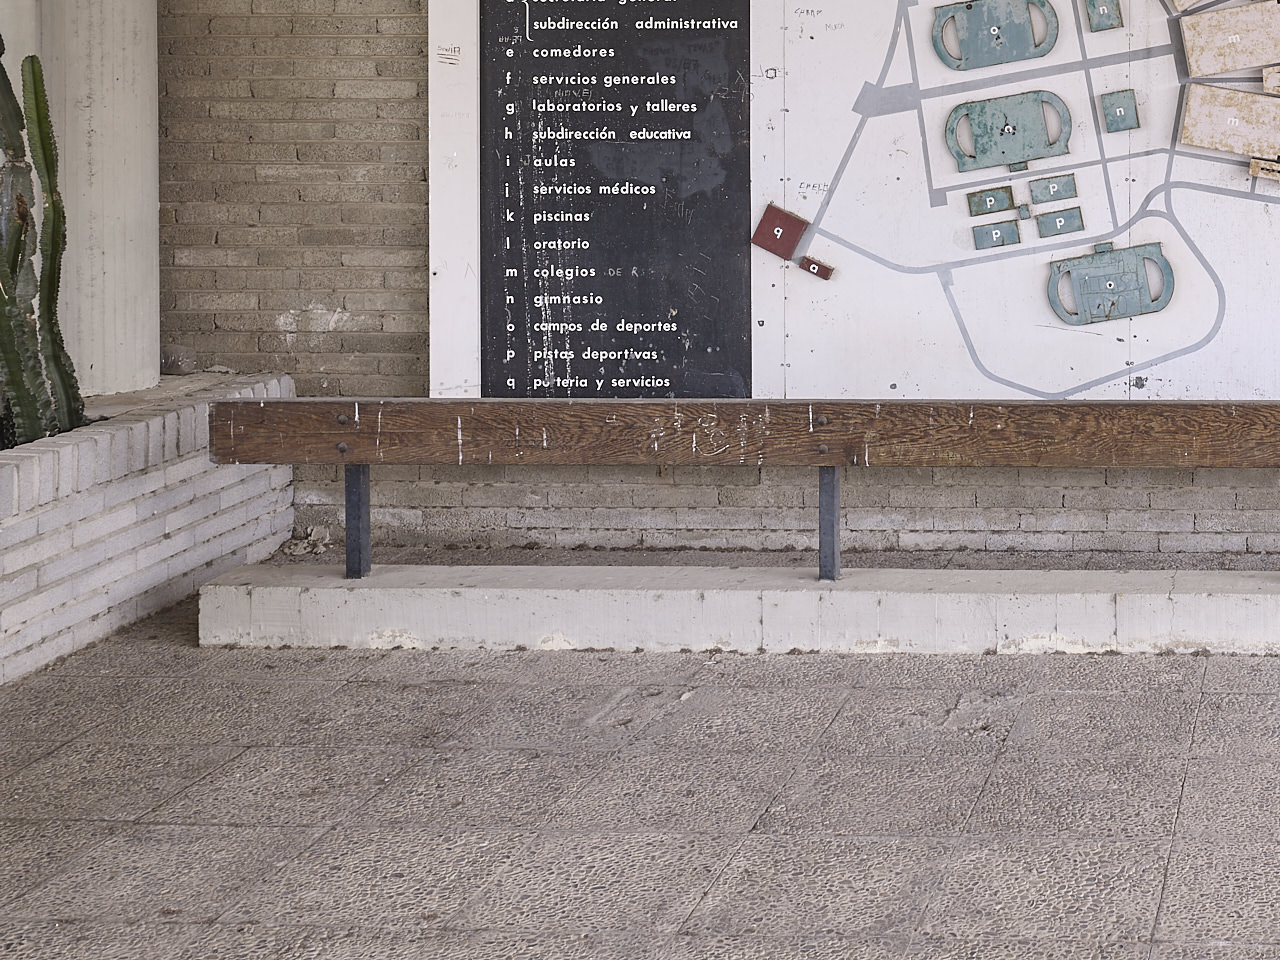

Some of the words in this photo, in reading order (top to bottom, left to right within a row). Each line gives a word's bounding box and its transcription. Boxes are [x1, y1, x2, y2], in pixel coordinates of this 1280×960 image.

[1099, 5, 1107, 15] n
[533, 17, 618, 30] subdirección
[635, 17, 738, 29] administrativa
[990, 26, 998, 35] o
[506, 49, 514, 57] e
[533, 45, 615, 57] comedores
[506, 73, 512, 85] f
[532, 74, 597, 85] servicios
[603, 73, 676, 87] generales
[505, 103, 514, 115] g
[532, 100, 622, 113] laboratorios
[630, 104, 638, 115] y
[646, 100, 697, 113] talleres
[1116, 107, 1124, 116] n
[504, 128, 513, 139] h
[532, 127, 615, 140] subdirección
[629, 128, 691, 140] educativa
[506, 155, 510, 166] i
[533, 155, 576, 167] aulas
[505, 184, 509, 197] j
[533, 184, 591, 195] servicios
[599, 183, 656, 195] médicos
[1049, 183, 1058, 195] p
[986, 197, 995, 208] p
[506, 210, 514, 222] k
[533, 211, 590, 224] piscinas
[1056, 217, 1065, 228] p
[773, 227, 783, 239] q
[992, 229, 1001, 241] p
[506, 238, 510, 249] l
[533, 238, 590, 250] oratorio
[505, 268, 517, 277] m
[533, 266, 596, 280] colegios
[810, 264, 818, 273] a
[1106, 281, 1114, 289] o
[506, 295, 515, 303] n
[534, 293, 603, 307] gimnasio
[507, 324, 515, 332] o
[534, 322, 582, 334] campos
[591, 319, 608, 332] de
[616, 319, 677, 334] deportes
[507, 350, 515, 361] p
[534, 348, 574, 361] pistas
[507, 378, 515, 389] q
[534, 376, 588, 390] poteria
[596, 379, 604, 390] y
[611, 376, 670, 387] servicios
